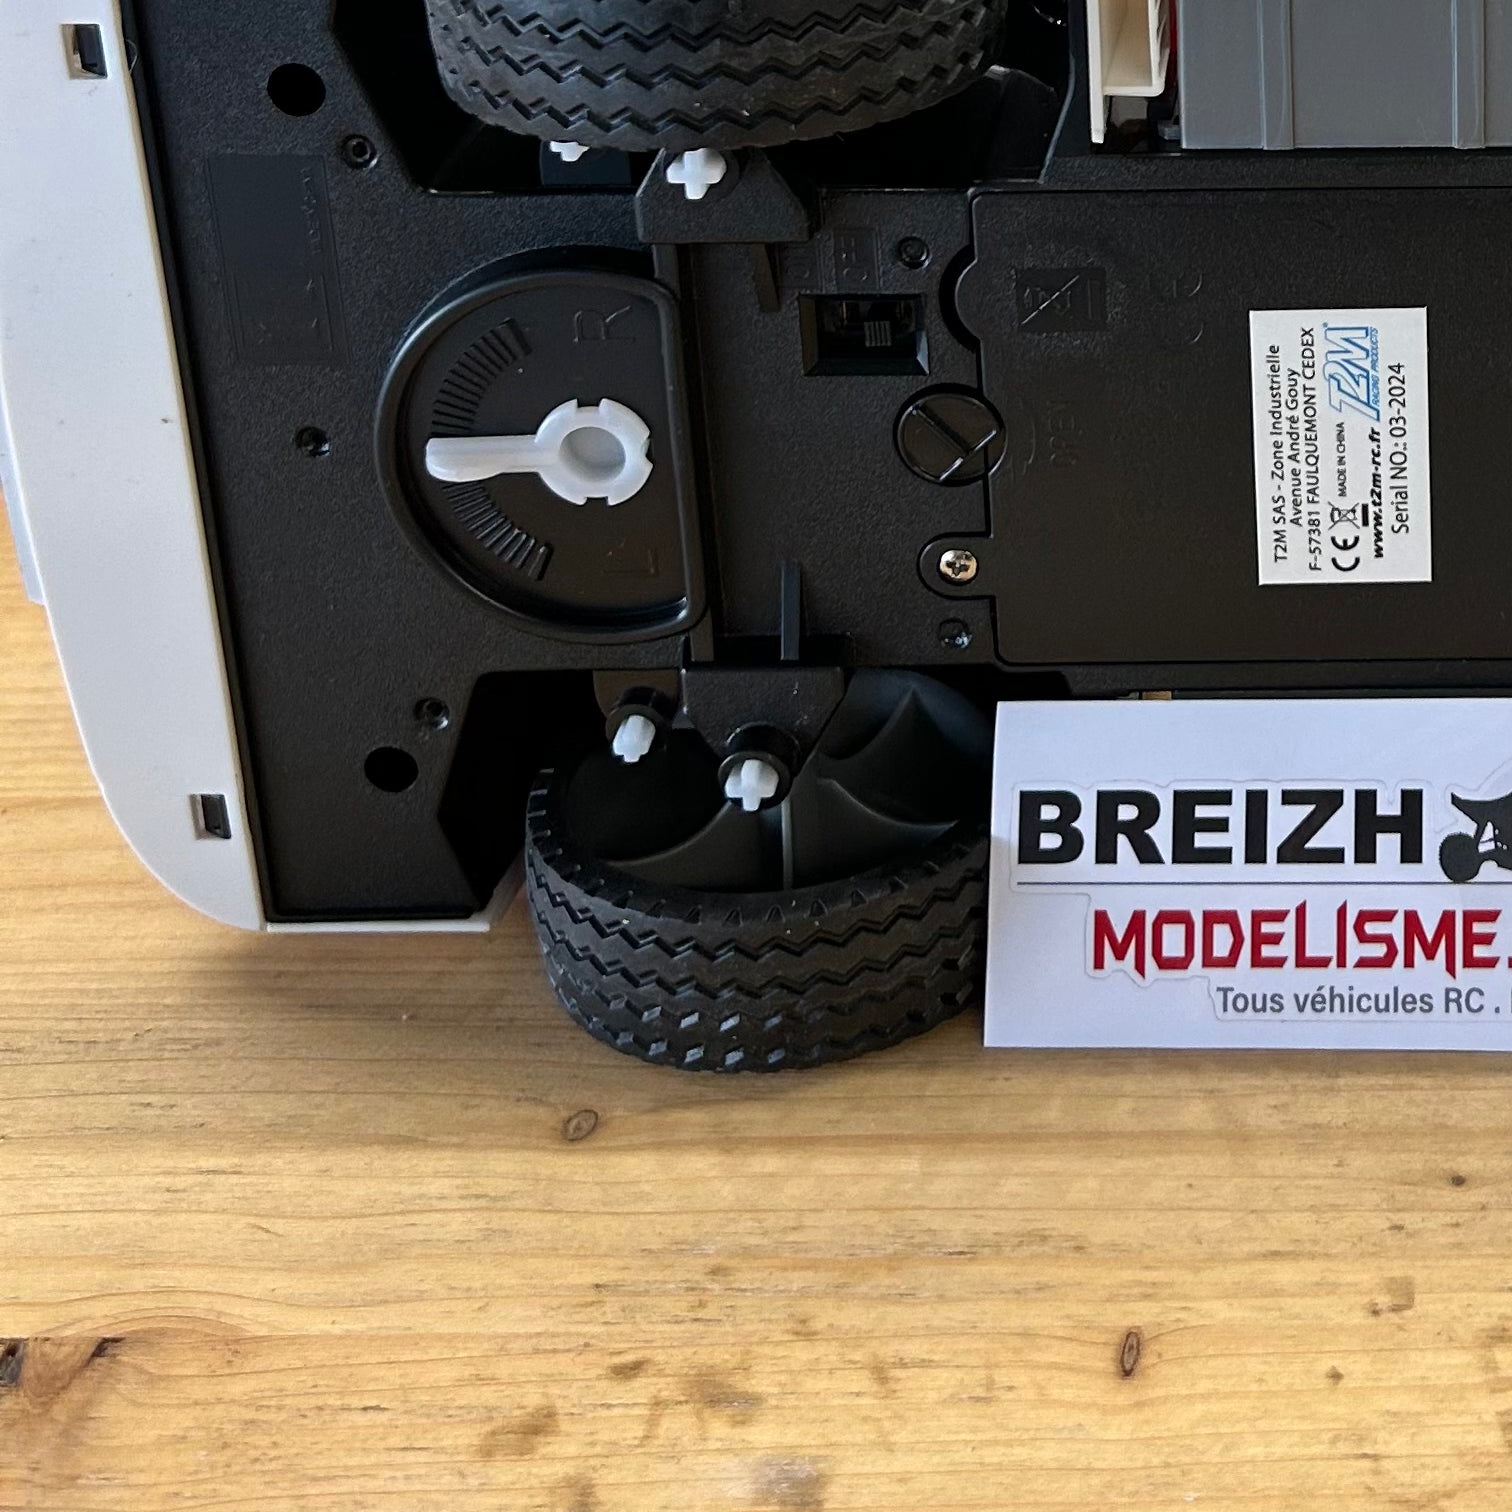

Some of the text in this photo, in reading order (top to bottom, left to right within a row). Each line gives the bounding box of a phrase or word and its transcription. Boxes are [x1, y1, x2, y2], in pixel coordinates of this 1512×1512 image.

[1266, 345, 1283, 435] Industrielle
[1323, 327, 1380, 422] T2M
[1369, 328, 1379, 407] RACING PRODUCTS
[1387, 363, 1407, 437] 03-2024
[1269, 441, 1284, 480] Zone
[1286, 368, 1303, 527] Avenue André Gouy
[1301, 328, 1322, 571] F-57381 FAULQUEMONT CEDEX
[1336, 422, 1347, 496] MADE IN CHINA
[1271, 496, 1286, 524] SAS
[1369, 427, 1384, 559] www.t2m-rc.fr
[1391, 485, 1409, 534] Serial
[1273, 529, 1287, 562] T2M
[1017, 788, 1424, 865] BREIZH
[1216, 986, 1285, 1016] Tous
[1293, 984, 1433, 1016] véhicules
[1444, 987, 1486, 1016] RC
